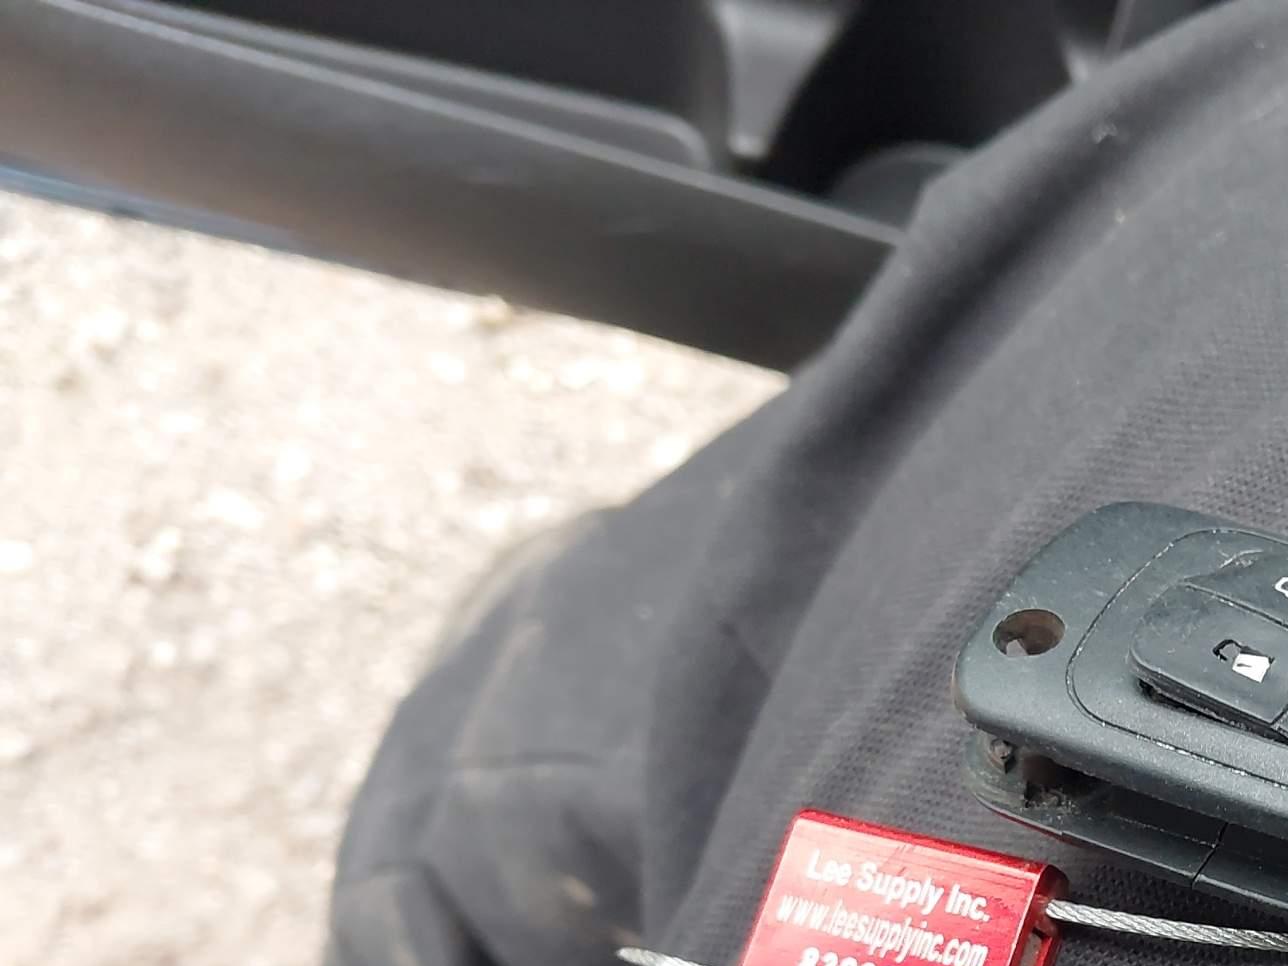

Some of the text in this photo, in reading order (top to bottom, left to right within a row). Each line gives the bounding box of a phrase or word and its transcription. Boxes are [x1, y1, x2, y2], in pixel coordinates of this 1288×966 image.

[808, 850, 990, 922] Lee Supply Inc.
